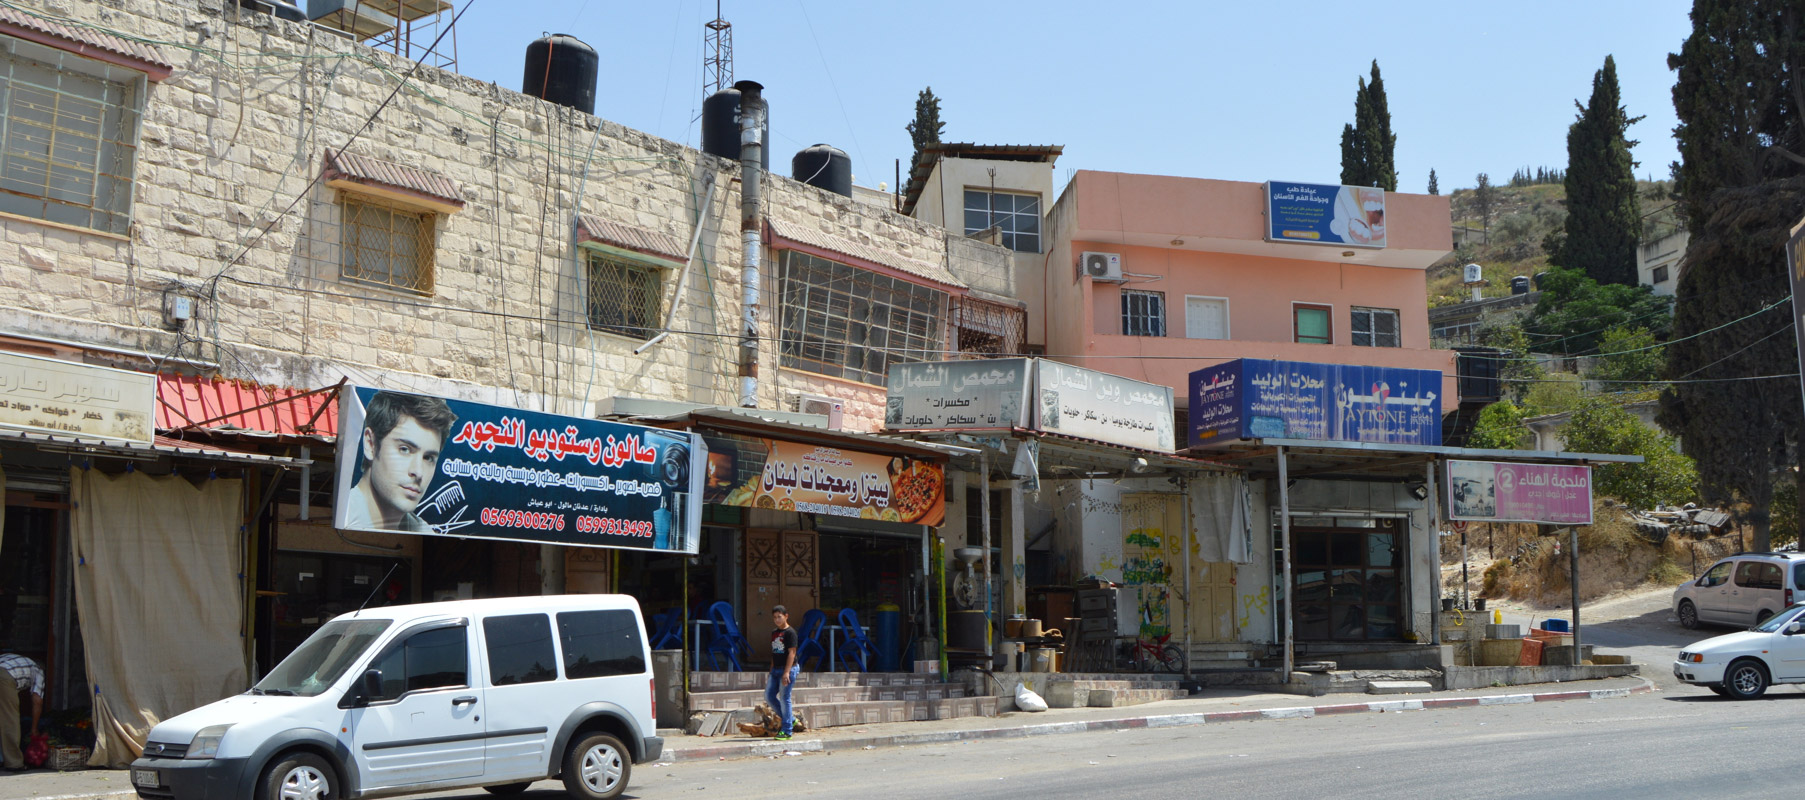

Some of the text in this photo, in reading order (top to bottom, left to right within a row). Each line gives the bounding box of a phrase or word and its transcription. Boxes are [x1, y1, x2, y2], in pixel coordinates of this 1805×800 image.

[1301, 186, 1317, 194] عيادة
[893, 364, 1015, 393] محمص الشمال
[1050, 366, 1093, 390] الشمال
[1251, 372, 1325, 389] محلات الوليد
[11, 402, 31, 411] مواد
[933, 398, 970, 409] مكسرات
[1124, 390, 1165, 406] محمص
[42, 405, 69, 417] فواكه
[82, 410, 103, 421] خضار
[905, 414, 997, 427] بن سكاكر حلويات
[453, 416, 657, 467] صالون وستوديو النجوم
[442, 459, 472, 477] نسائية
[480, 463, 505, 483] رجالية
[506, 466, 537, 485] فرنسية
[536, 470, 560, 487] عطور
[763, 460, 890, 508] بيتزا ومعجنات لبنان
[1502, 472, 1587, 488] ملحمة الهناء 2
[615, 480, 638, 496] تصوير
[640, 483, 662, 497] قص
[481, 507, 565, 531] 0569300276
[576, 515, 653, 537] 0599313492
